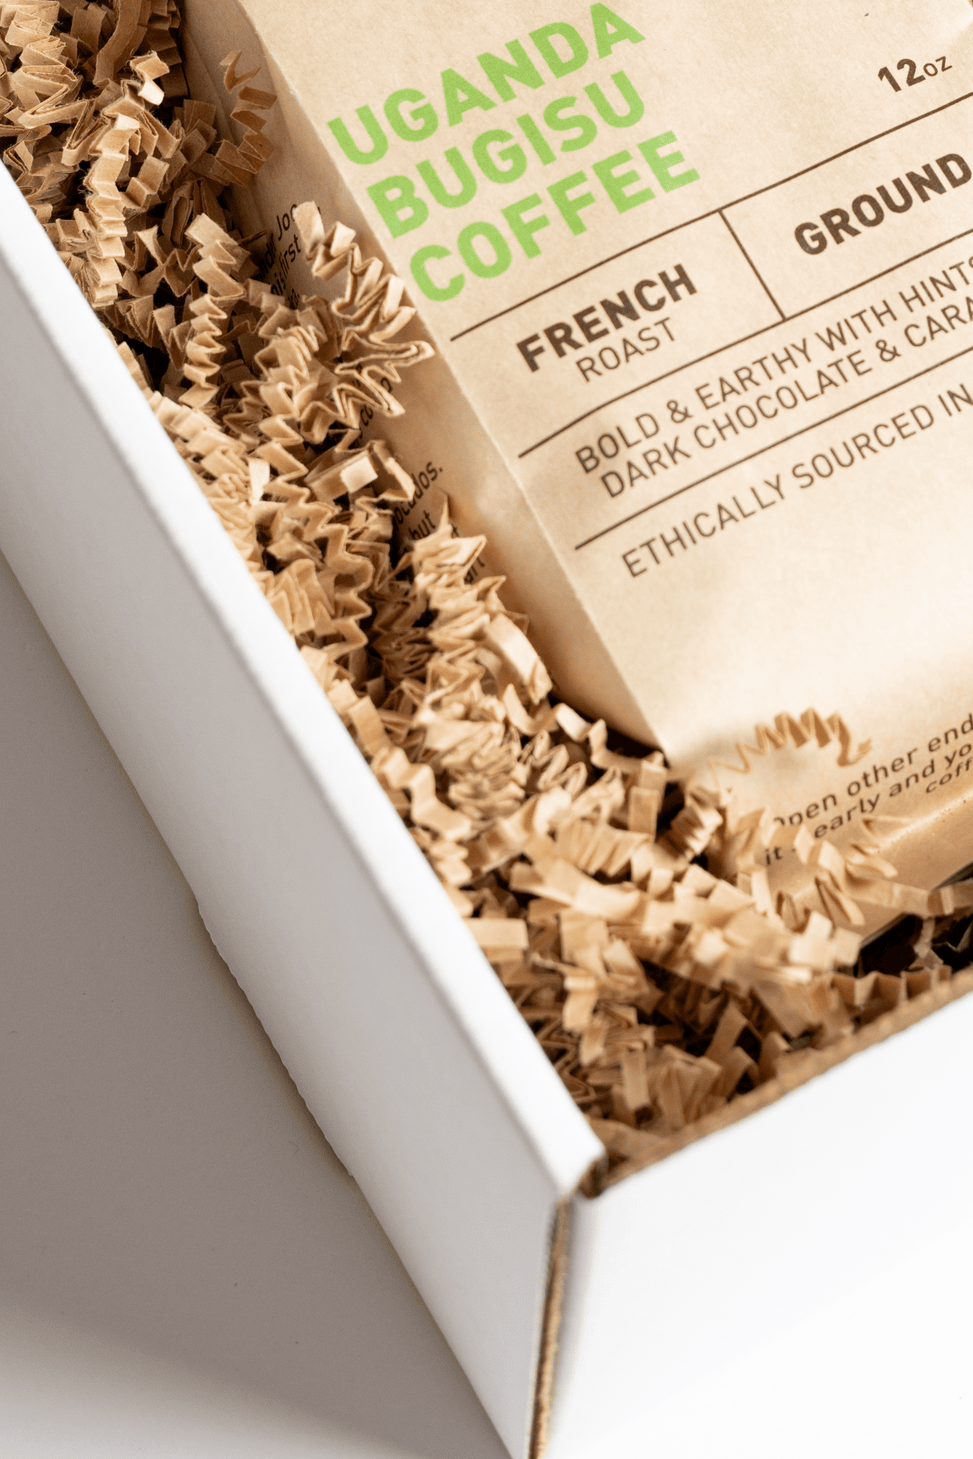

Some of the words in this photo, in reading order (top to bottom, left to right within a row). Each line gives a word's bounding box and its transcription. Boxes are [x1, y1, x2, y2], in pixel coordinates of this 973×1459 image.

[327, 2, 647, 165] UGANDA
[367, 71, 644, 238] BUGISU
[409, 130, 701, 302] COFFEE
[793, 152, 973, 256] GROUND
[516, 263, 699, 372] FRENCH
[575, 412, 659, 474] BOLD
[666, 399, 693, 424] &
[695, 336, 811, 411] EARTHY
[815, 301, 899, 352] WITH
[576, 317, 678, 383] ROAST
[600, 441, 692, 499] DARK
[694, 353, 873, 450] CHOCOLATE
[876, 338, 902, 361] &
[621, 473, 786, 579] ETHICALLY
[792, 405, 934, 490] SOURCED
[814, 793, 880, 840] early
[888, 759, 935, 798] and
[847, 746, 918, 797] other
